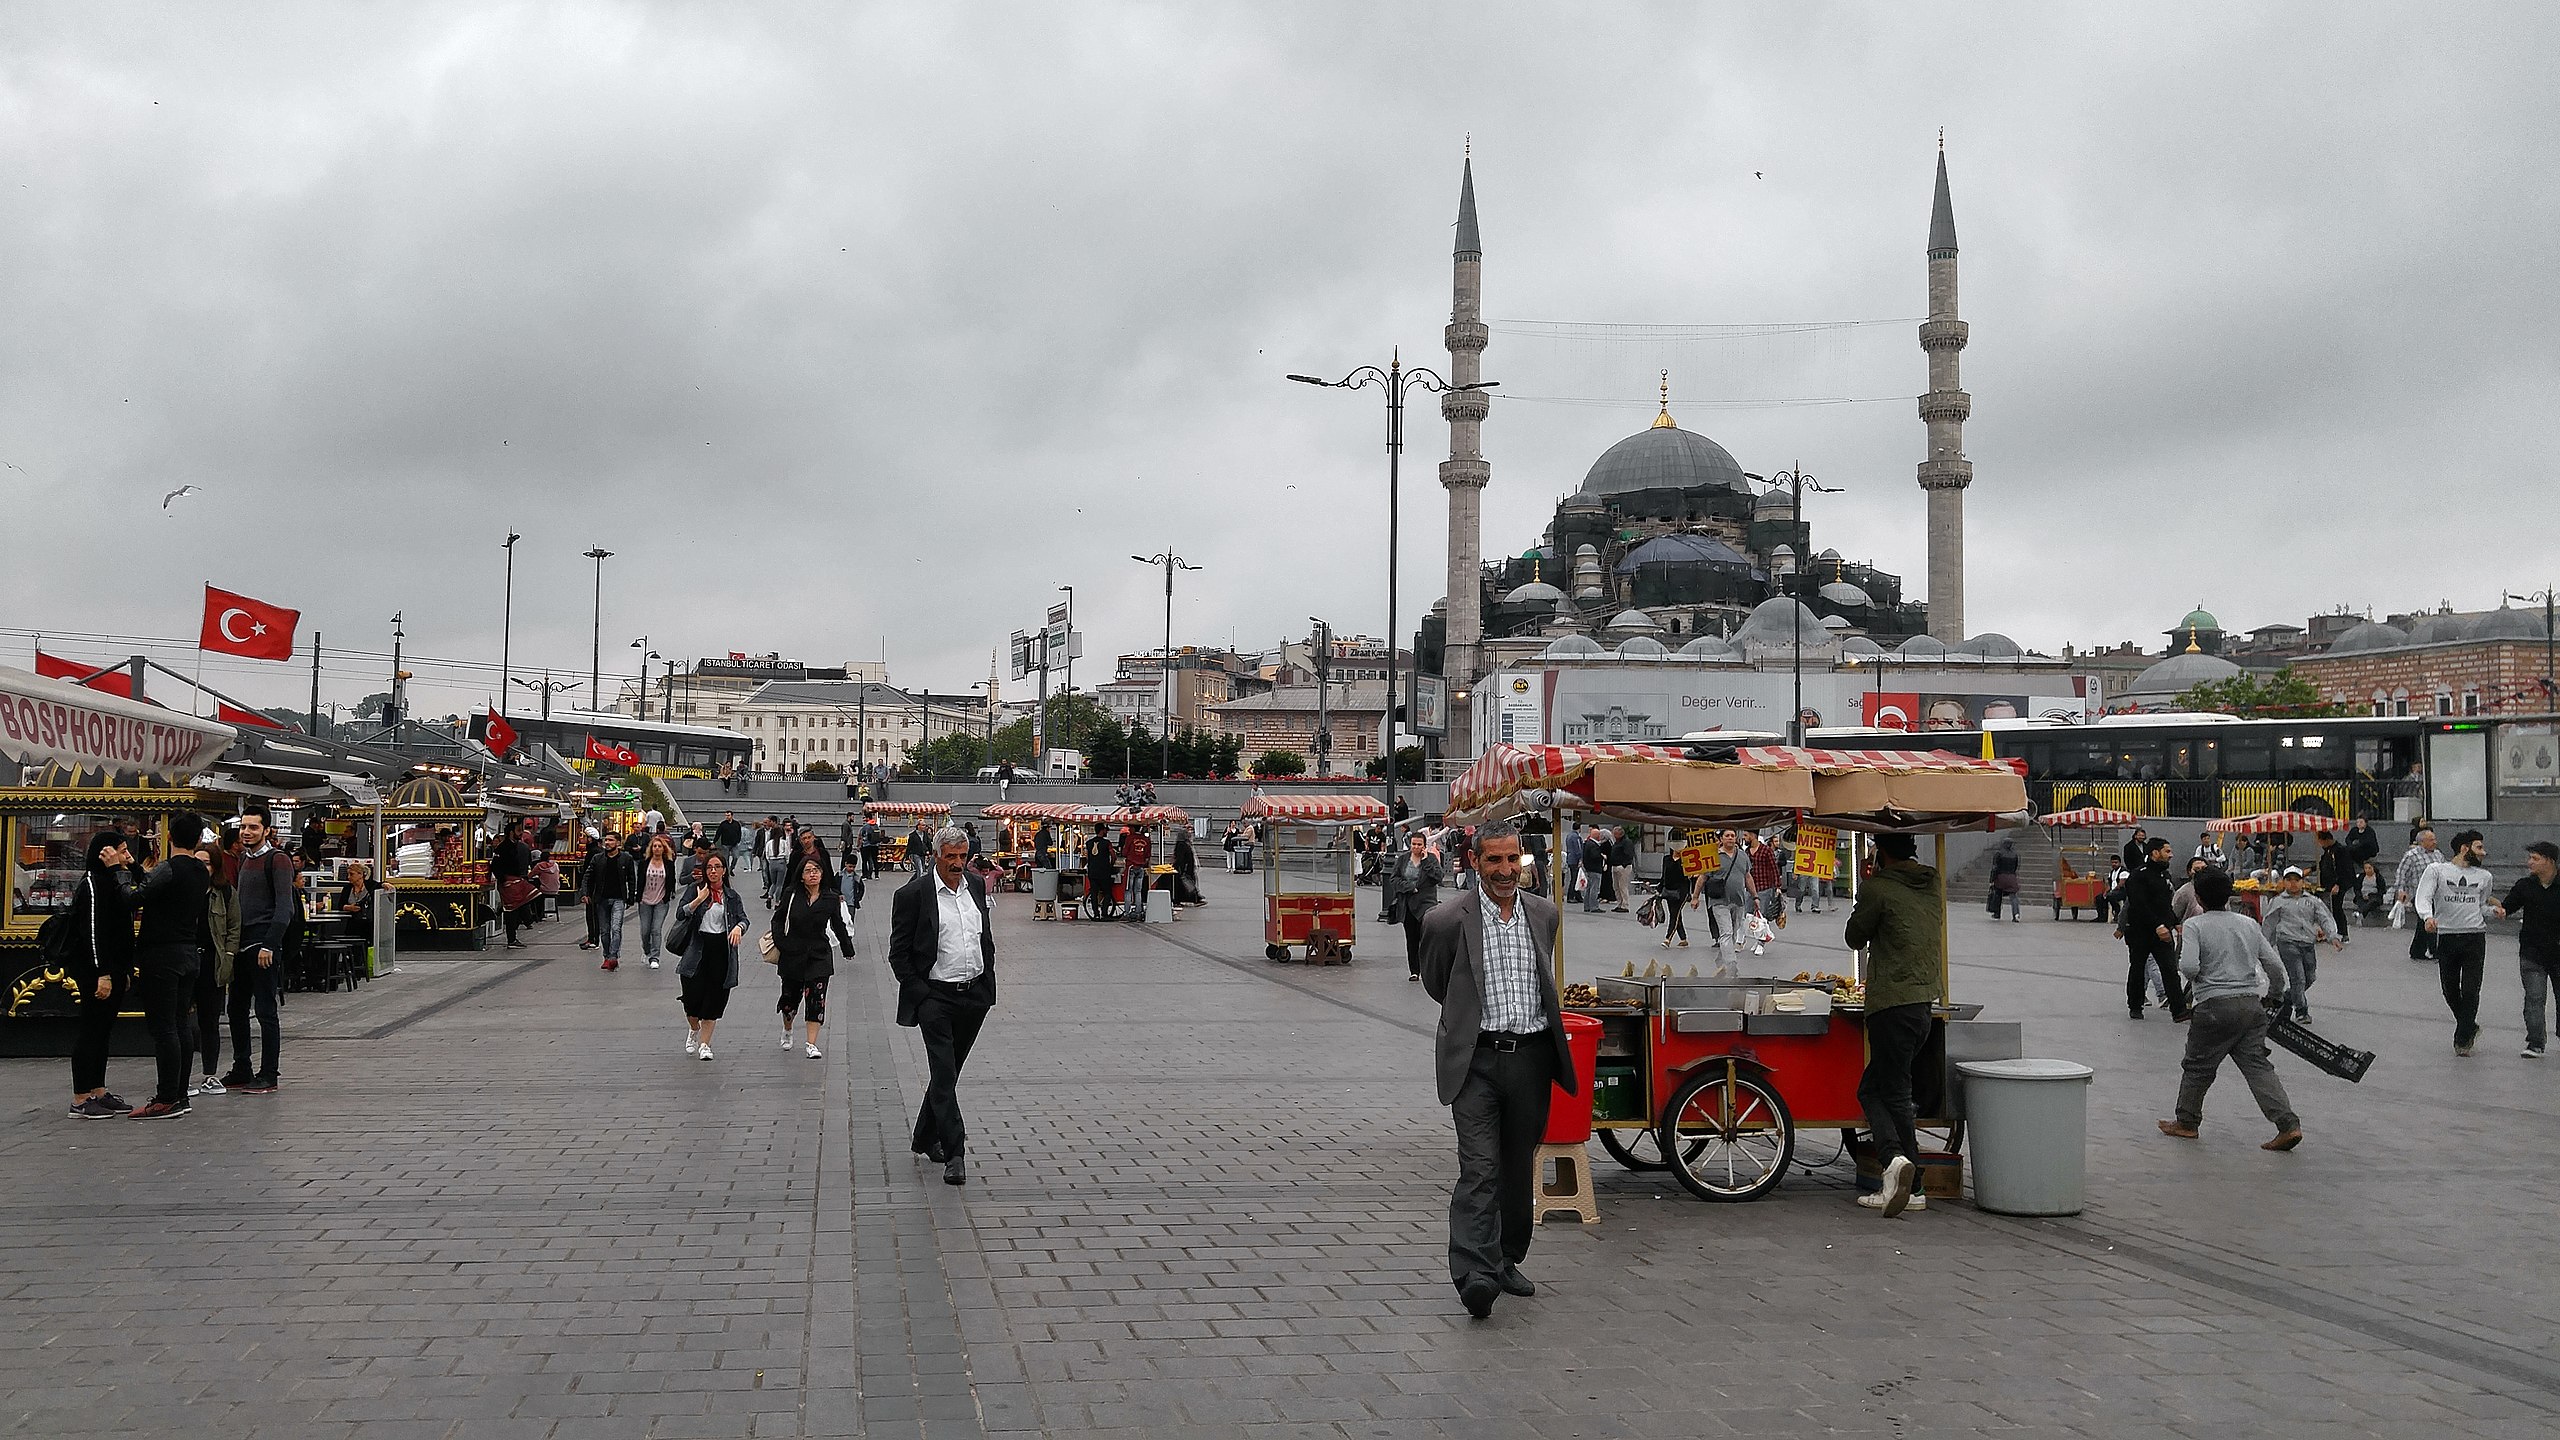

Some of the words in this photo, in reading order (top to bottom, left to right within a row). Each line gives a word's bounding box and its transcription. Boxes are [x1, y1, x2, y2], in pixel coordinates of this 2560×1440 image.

[777, 661, 801, 670] ODASI
[1682, 695, 1722, 710] Değer
[0, 694, 145, 763] BOSPHORUS
[152, 725, 204, 766] TOUR
[1798, 833, 1836, 851] MISIR
[1682, 849, 1703, 873] 3
[1702, 856, 1721, 870] TL
[1796, 848, 1817, 873] 3
[1817, 863, 1832, 876] TL
